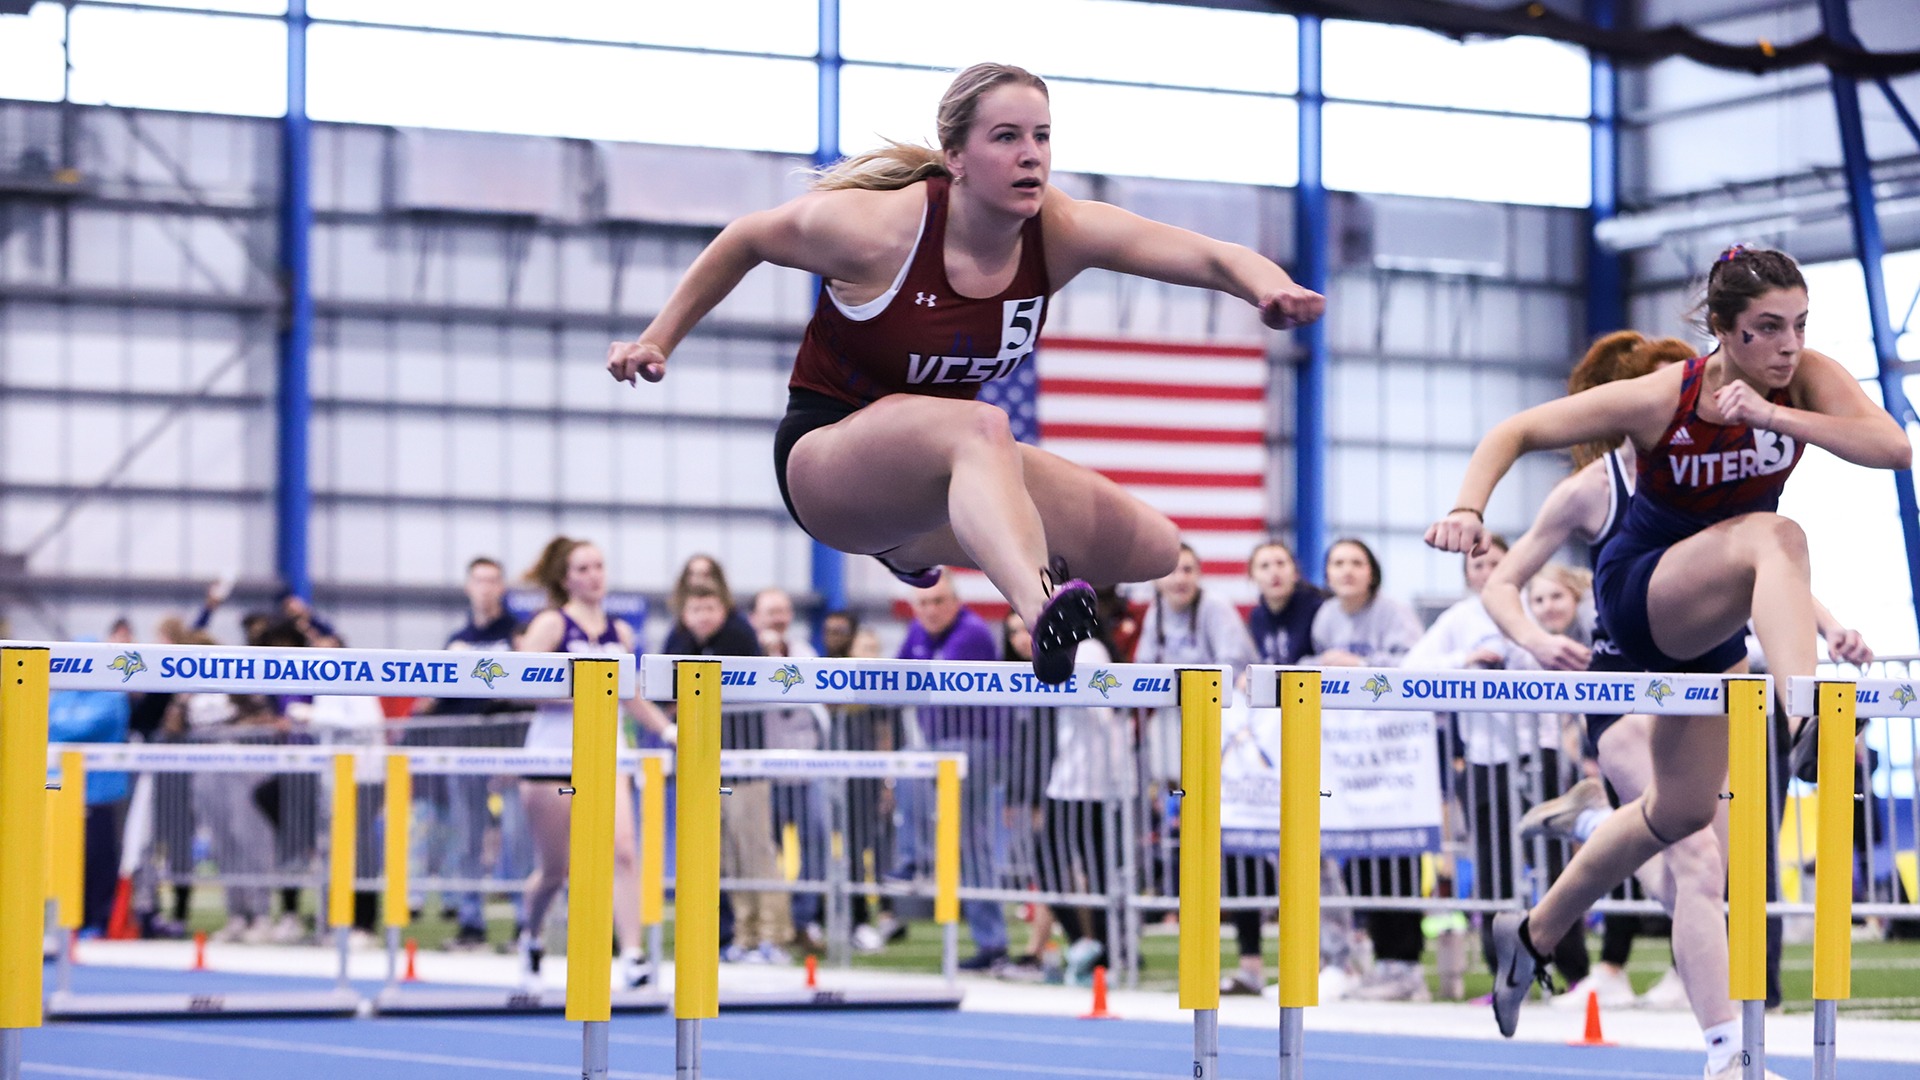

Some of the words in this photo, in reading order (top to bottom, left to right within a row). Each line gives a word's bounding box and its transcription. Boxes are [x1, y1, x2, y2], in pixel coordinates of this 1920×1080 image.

[1006, 300, 1037, 350] 5
[1762, 428, 1786, 467] 3
[50, 657, 94, 674] GILL
[160, 656, 256, 680] SOUTH
[262, 659, 375, 682] DAKOTA
[380, 661, 459, 684] STATE
[520, 667, 565, 683] GILL
[815, 669, 900, 691] SOUTH
[905, 670, 1004, 693] DAKOTA
[1132, 677, 1171, 693] GILL
[1401, 679, 1477, 700] SOUTH
[1482, 680, 1570, 701] DAKOTA
[1574, 682, 1636, 702] STATE
[1684, 687, 1719, 701] GILL
[1856, 690, 1880, 704] ILL
